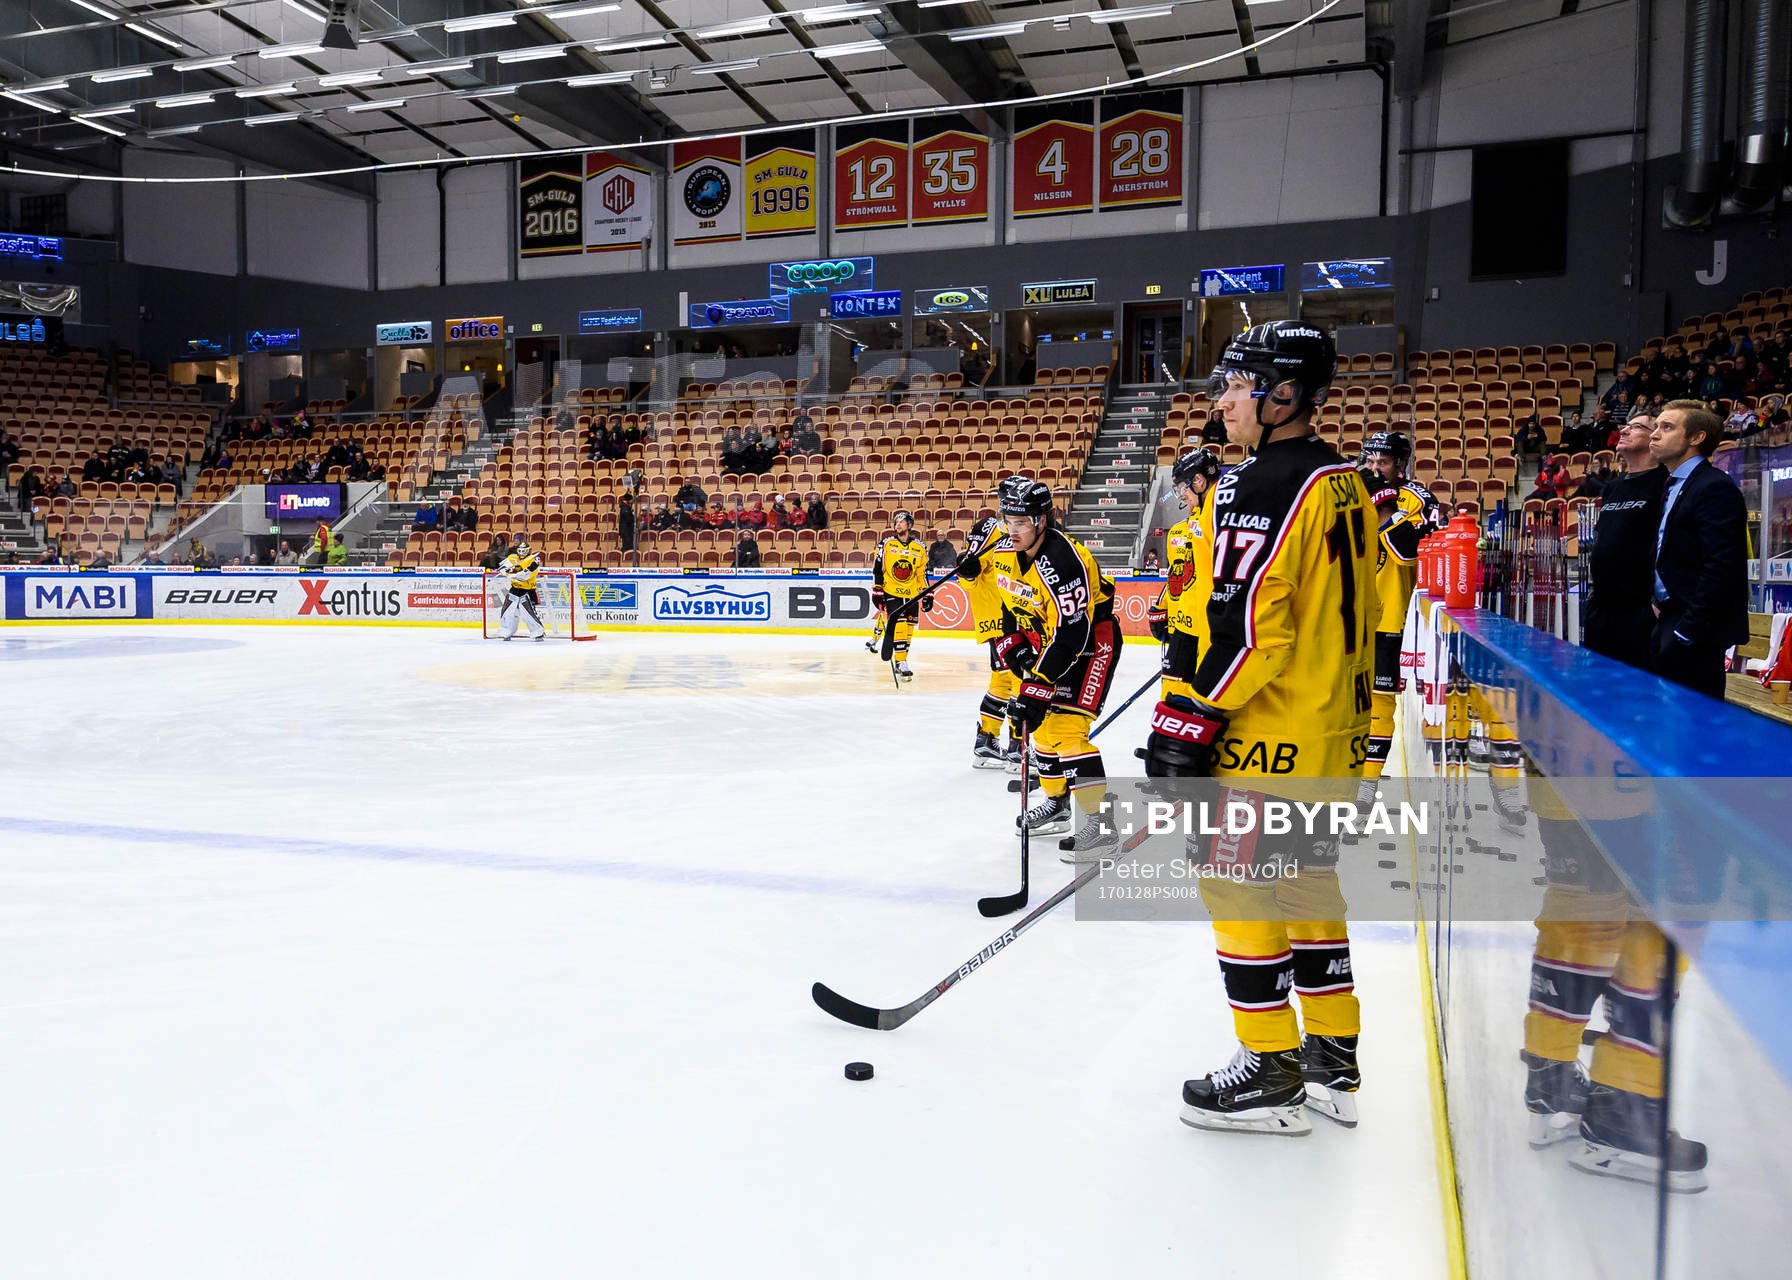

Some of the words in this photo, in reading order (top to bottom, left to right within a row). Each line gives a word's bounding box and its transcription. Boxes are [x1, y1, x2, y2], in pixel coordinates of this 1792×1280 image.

[1036, 139, 1067, 185] 4
[1111, 128, 1170, 178] 28
[688, 169, 726, 189] EUROPEAN
[754, 166, 808, 183] SM-GULD
[848, 156, 895, 201] 12
[922, 148, 977, 194] 35
[527, 189, 575, 207] SM-GULD
[605, 179, 633, 211] CHL
[752, 185, 809, 216] 1996
[933, 199, 966, 208] MYLLYS
[1034, 190, 1072, 200] NILSSON
[525, 208, 577, 237] 2016
[1696, 240, 1727, 285] J
[1056, 285, 1089, 299] LULEÅ
[725, 306, 775, 319] SCANIA
[834, 297, 897, 313] KONTEX
[450, 320, 499, 339] office
[1228, 512, 1271, 530] LKAB
[1212, 529, 1267, 581] 17
[1038, 555, 1060, 584] SSAB
[1065, 577, 1081, 591] LKAB
[36, 585, 126, 609] MABI
[659, 596, 765, 615] ÄLVSBYHUS
[1058, 586, 1087, 616] 52
[586, 611, 602, 621] och
[605, 611, 639, 621] Kontor
[1024, 686, 1053, 699] BAU
[1151, 711, 1204, 739] UER
[957, 929, 1017, 980] BAUER
